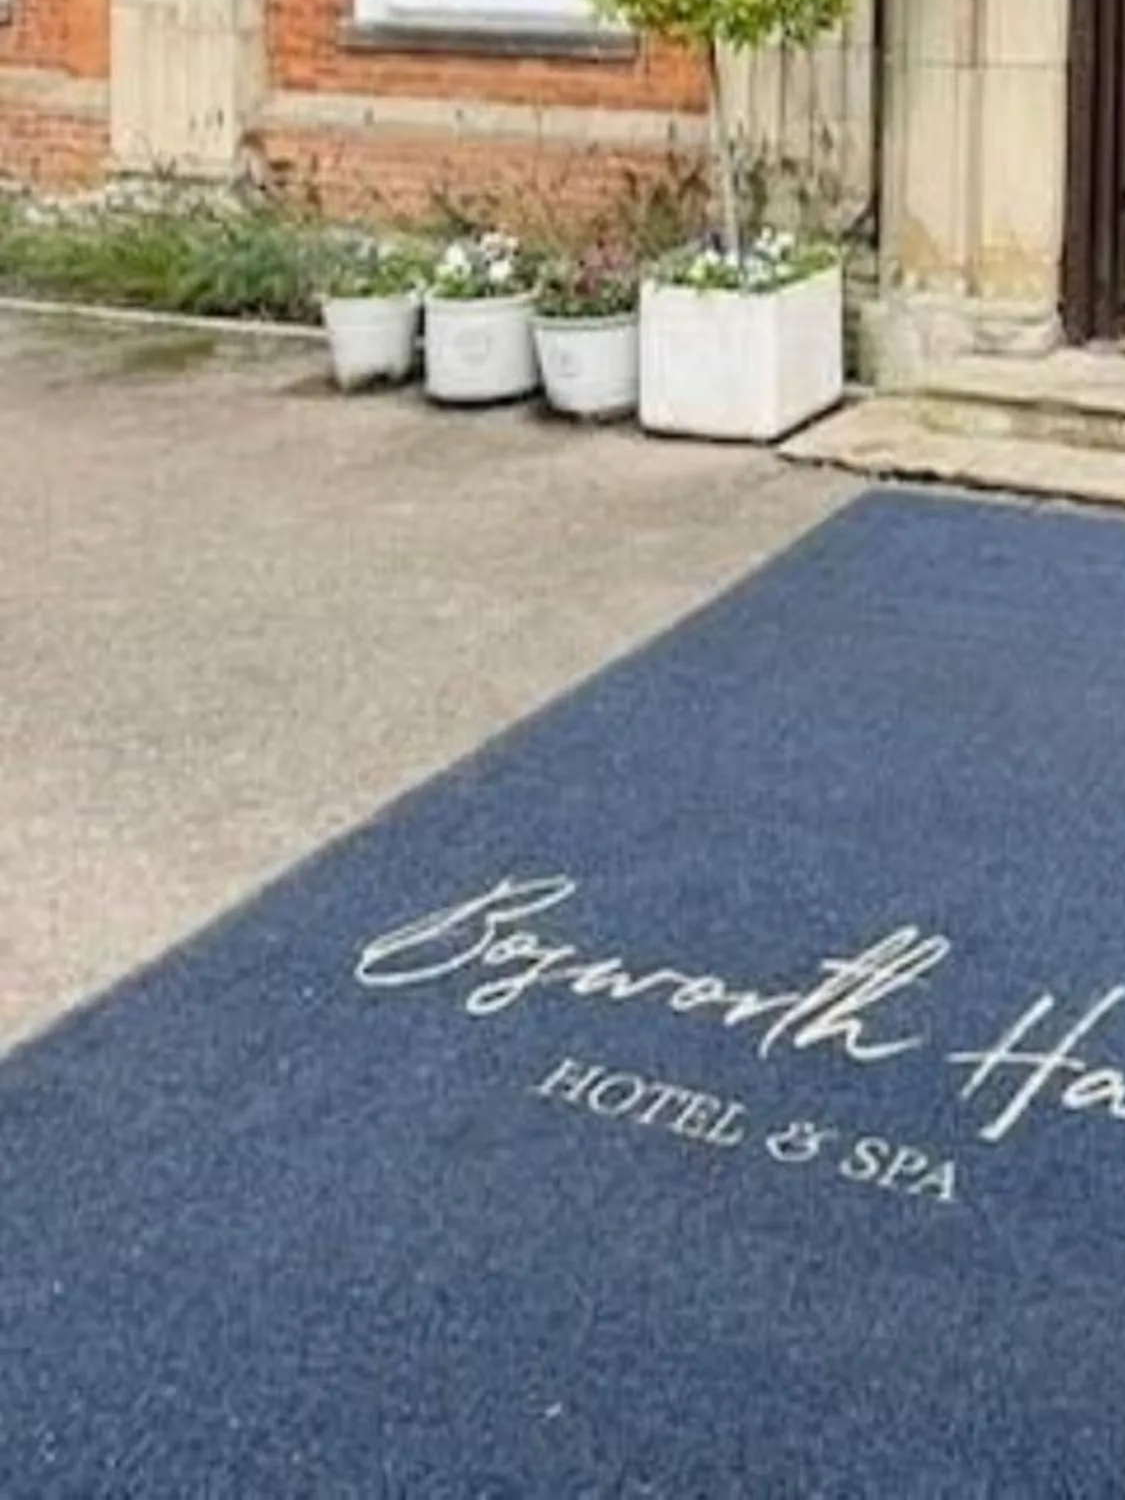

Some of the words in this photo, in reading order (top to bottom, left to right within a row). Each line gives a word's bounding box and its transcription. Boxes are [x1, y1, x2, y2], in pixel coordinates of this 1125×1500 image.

[535, 1058, 748, 1146] HOTEL
[765, 1121, 832, 1162] &
[840, 1137, 957, 1201] SPA
